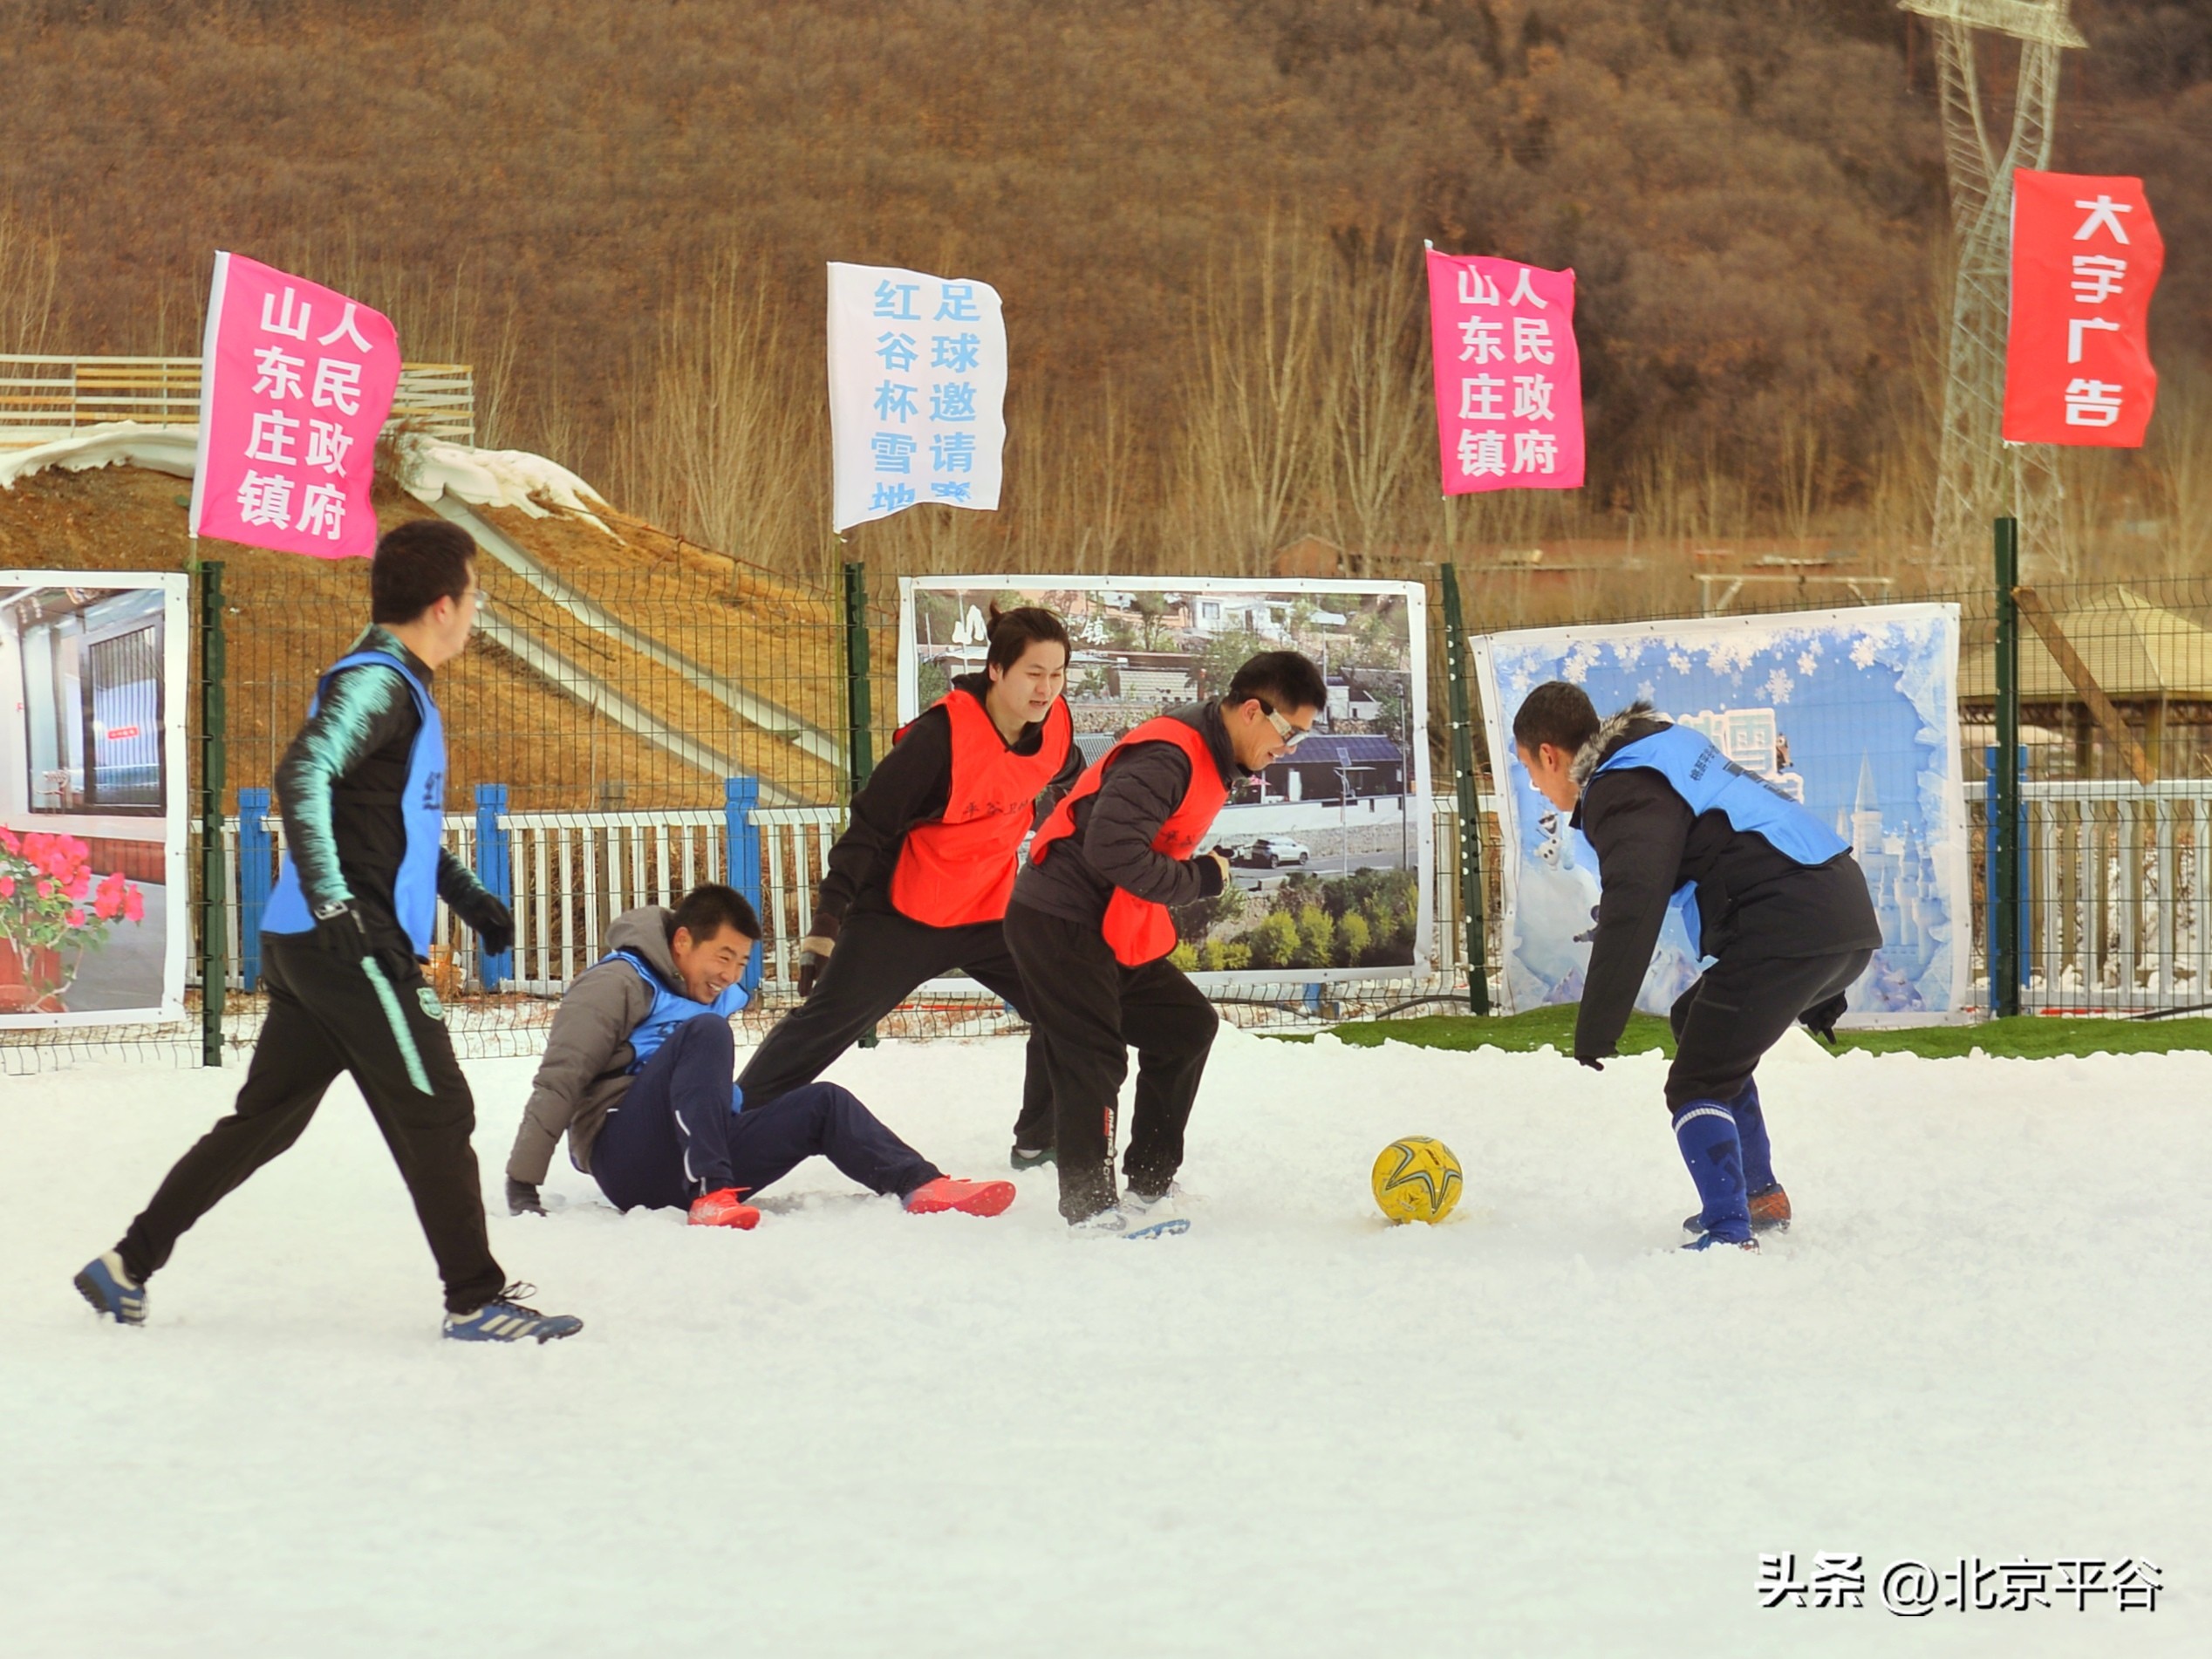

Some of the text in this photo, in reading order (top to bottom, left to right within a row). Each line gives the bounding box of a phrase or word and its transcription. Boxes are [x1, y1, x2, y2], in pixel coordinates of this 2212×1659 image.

[236, 286, 312, 531] 山东庄镇
[295, 302, 374, 542] 人民政府
[868, 279, 921, 513] 红谷杯雪地
[1457, 264, 1506, 477] 山东庄镇
[1507, 267, 1559, 475] 人民政府
[2065, 195, 2133, 427] 大宇广告
